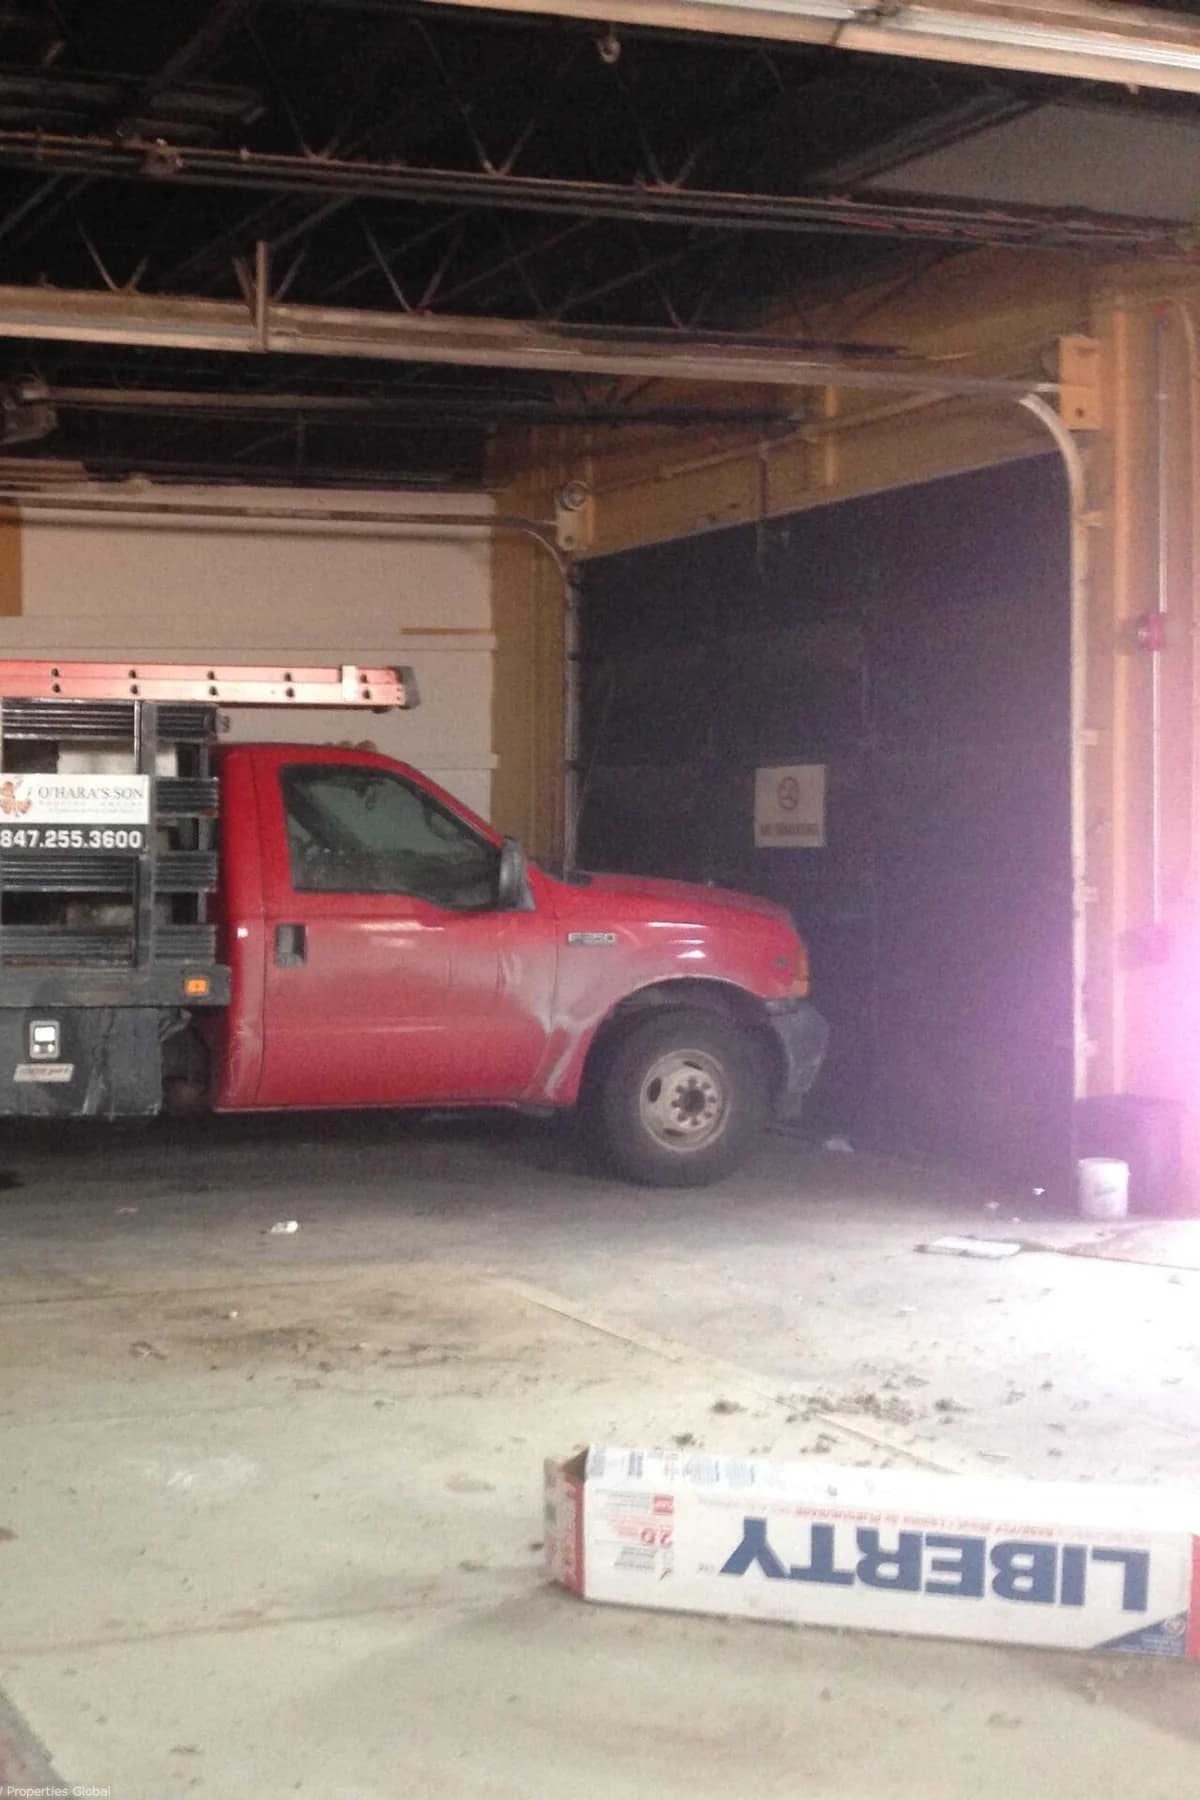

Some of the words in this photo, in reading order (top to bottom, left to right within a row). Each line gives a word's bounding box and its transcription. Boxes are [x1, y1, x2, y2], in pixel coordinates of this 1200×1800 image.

[38, 786, 109, 800] O'HARA'S
[113, 786, 143, 800] SON
[0, 829, 141, 849] 847.255.3600
[719, 1516, 1149, 1612] LIBERTY
